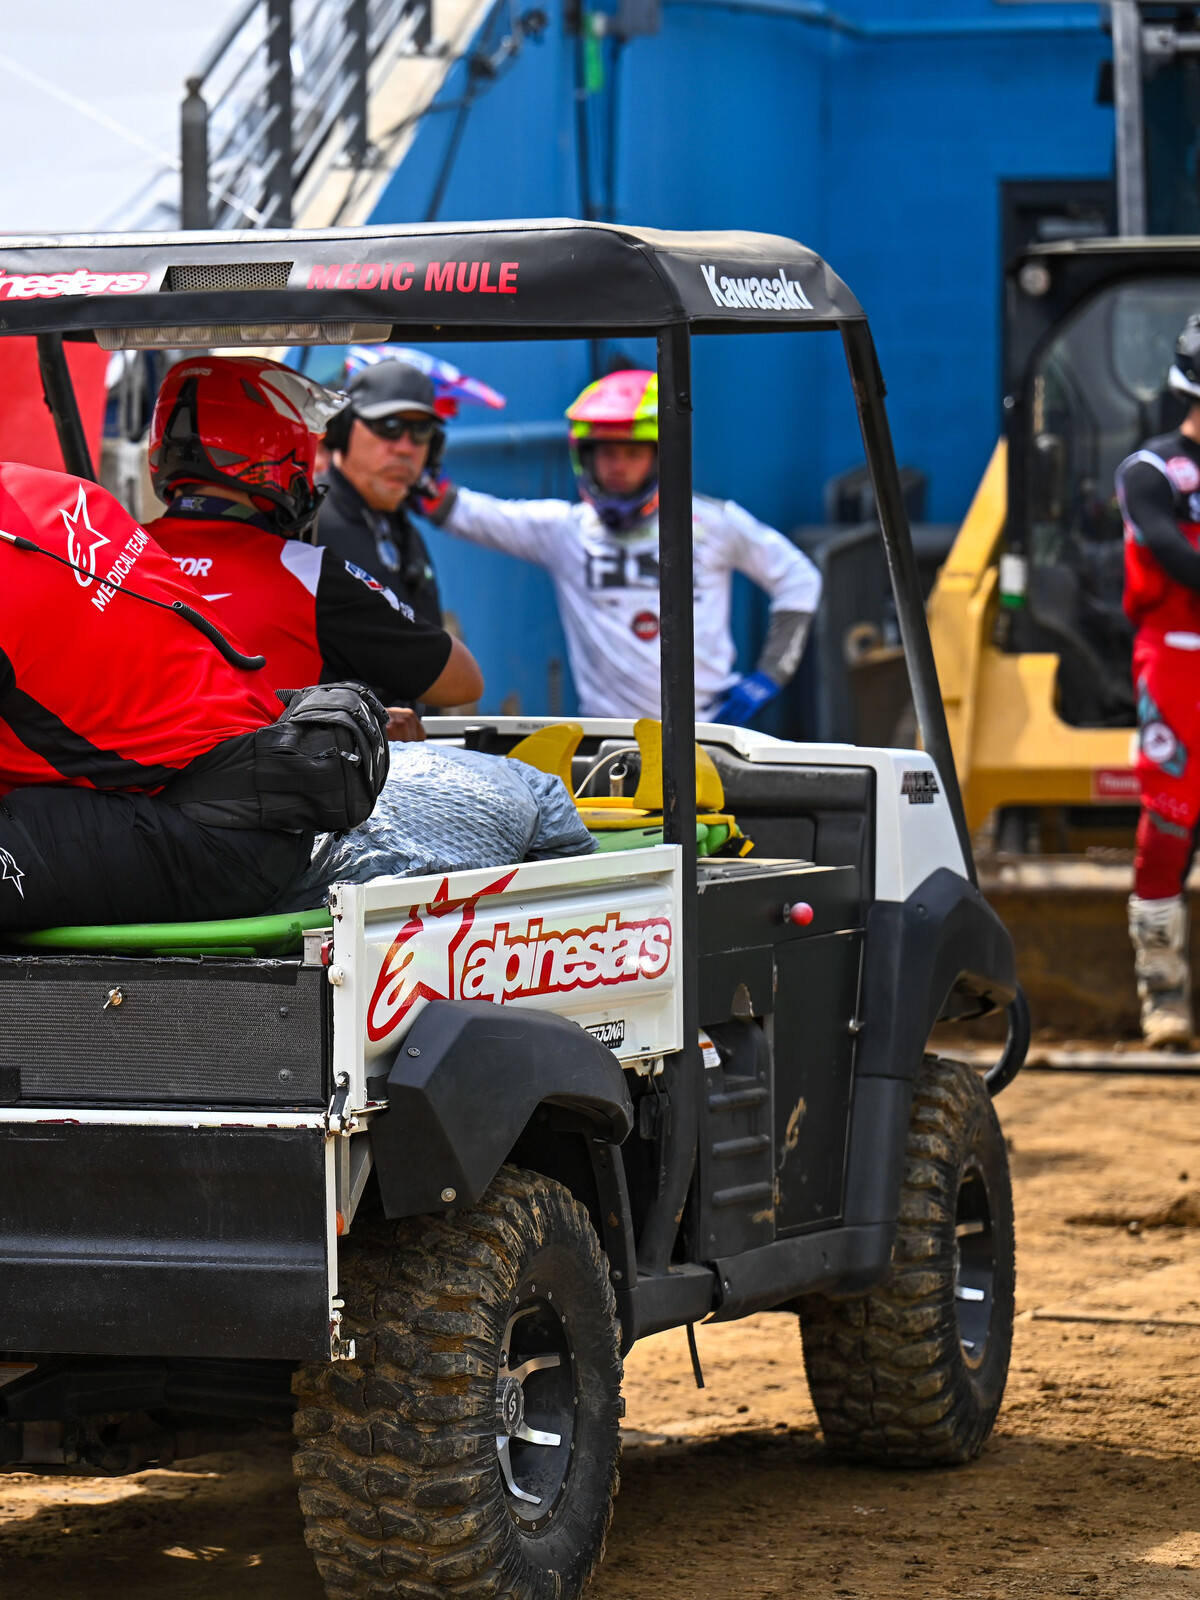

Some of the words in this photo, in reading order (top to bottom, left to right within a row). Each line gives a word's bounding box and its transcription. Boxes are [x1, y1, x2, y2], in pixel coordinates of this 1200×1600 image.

[306, 262, 414, 291] MEDIC
[423, 262, 520, 294] MULE
[699, 264, 815, 312] Kawasaki
[91, 552, 137, 612] MEDICAL
[124, 527, 150, 557] TEAM
[462, 912, 672, 1004] alpinestars
[586, 1021, 624, 1042] DONA
